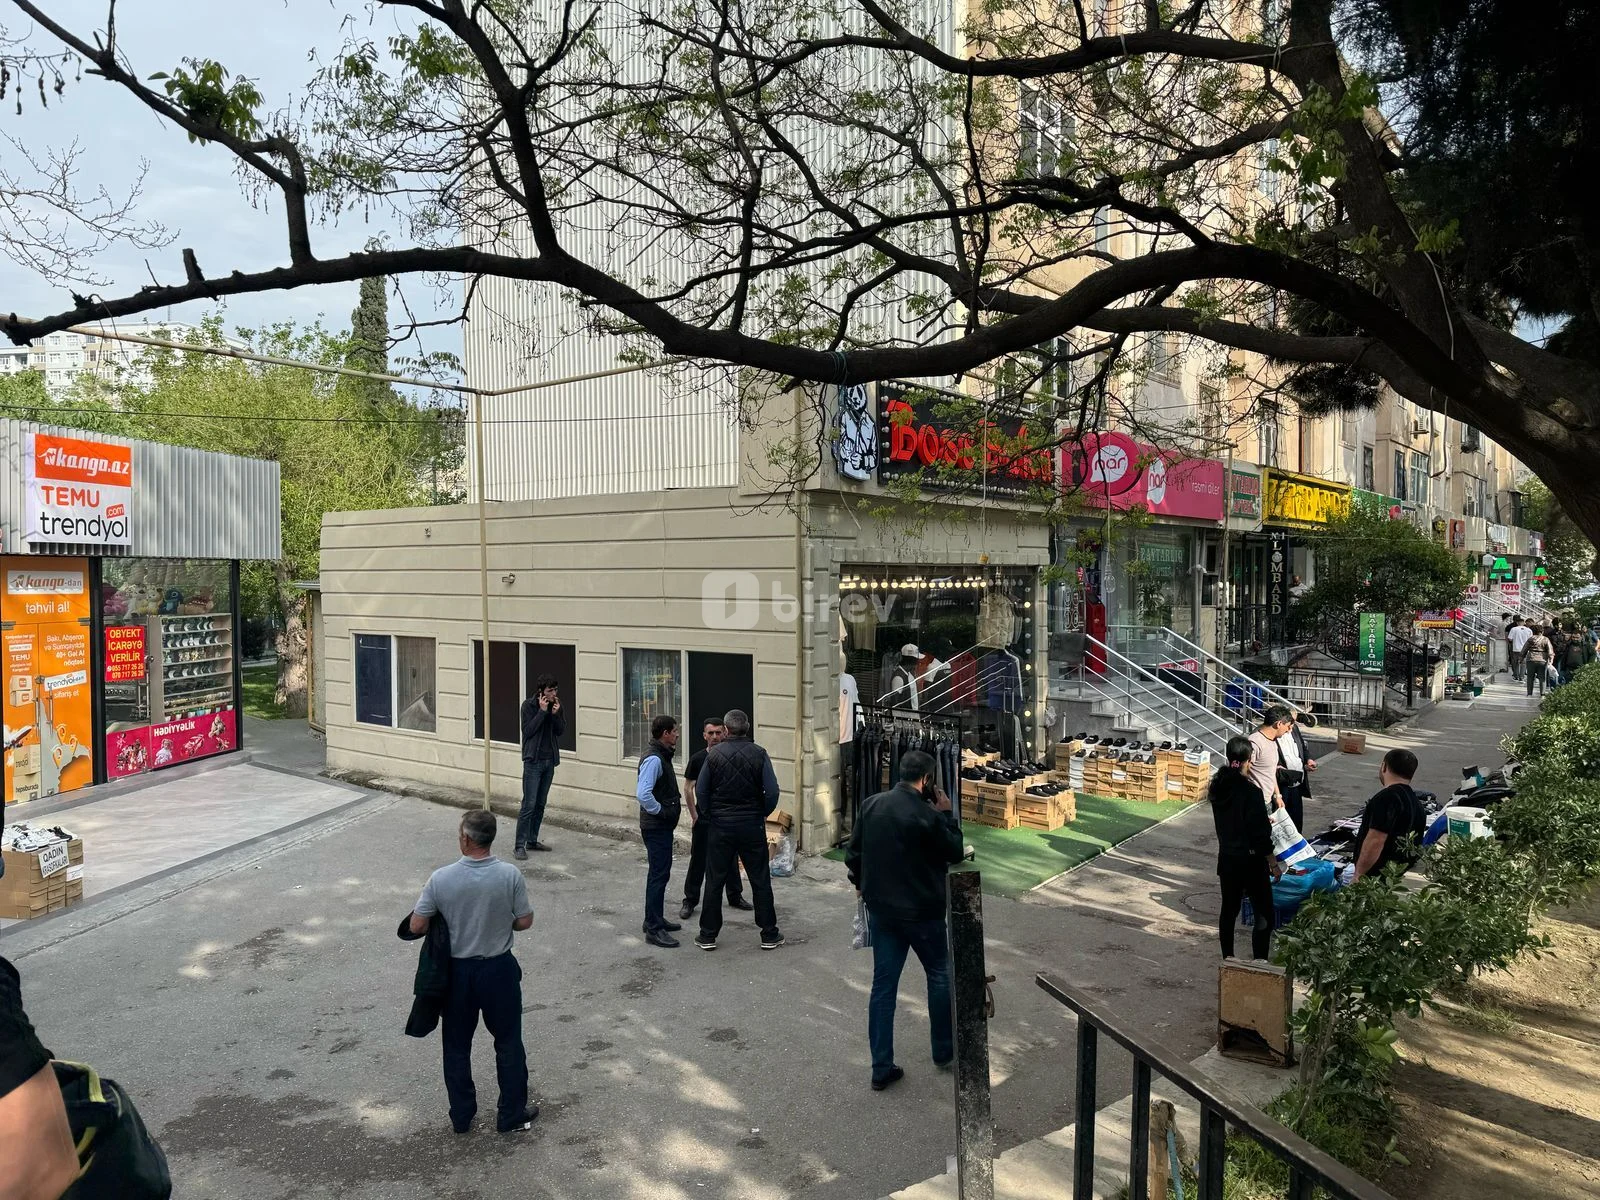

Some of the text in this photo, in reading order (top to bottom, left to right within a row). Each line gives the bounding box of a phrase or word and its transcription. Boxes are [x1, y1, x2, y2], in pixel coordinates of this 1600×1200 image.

[1094, 456, 1127, 471] nar
[41, 485, 100, 508] TEMU
[40, 511, 128, 542] trendyol
[26, 601, 55, 615] təhvil
[109, 628, 141, 639] OBYEKT
[108, 640, 143, 651] İCARƏYƏ
[11, 654, 31, 662] TEMU
[110, 651, 141, 663] VERİLİR
[153, 720, 196, 737] HƏDİYYƏLİK
[43, 845, 64, 863] QADIN
